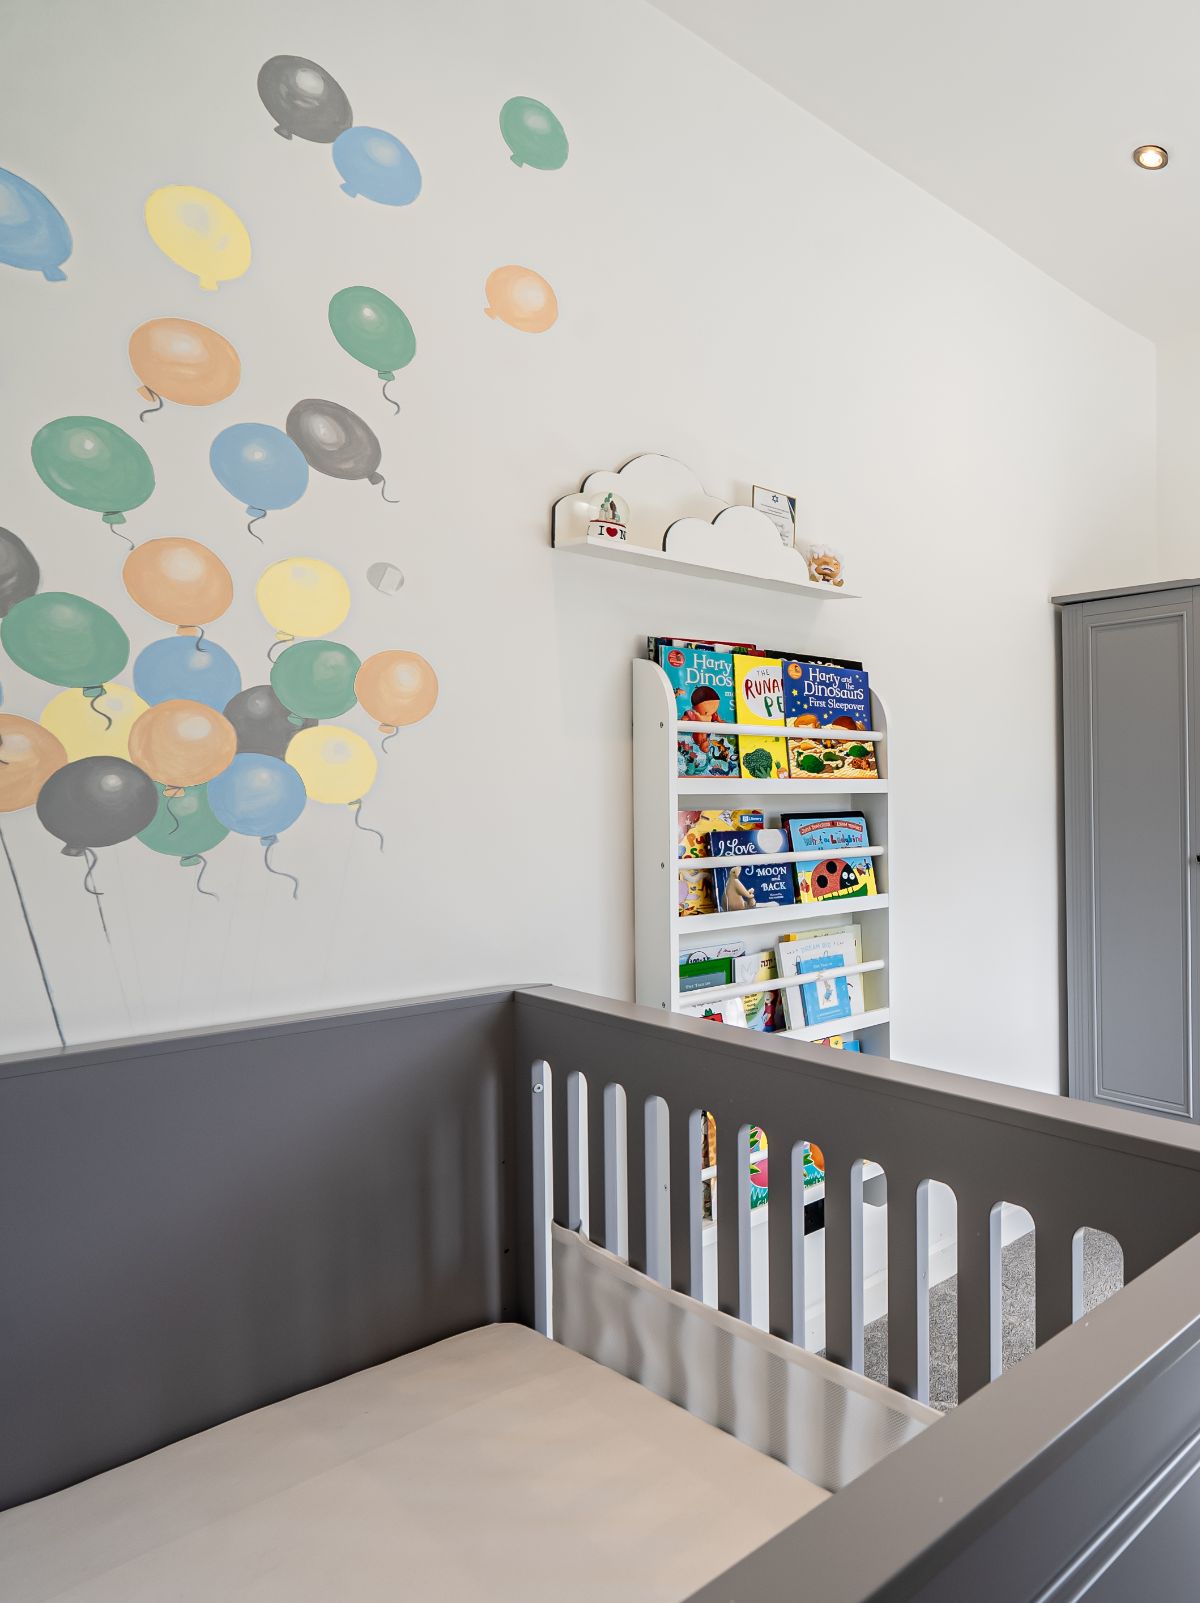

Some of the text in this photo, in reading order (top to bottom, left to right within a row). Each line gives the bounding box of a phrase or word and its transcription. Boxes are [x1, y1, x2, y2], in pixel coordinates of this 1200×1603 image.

[598, 525, 605, 535] I
[693, 653, 732, 676] Harry
[685, 667, 734, 687] Dinos
[809, 667, 853, 688] Harry and
[745, 677, 784, 700] RUNA
[803, 680, 864, 700] Dinosaurs
[764, 695, 785, 717] PE
[809, 697, 865, 711] First Sleepover
[725, 838, 758, 857] Love
[755, 866, 787, 877] MOON
[760, 881, 787, 892] BACK
